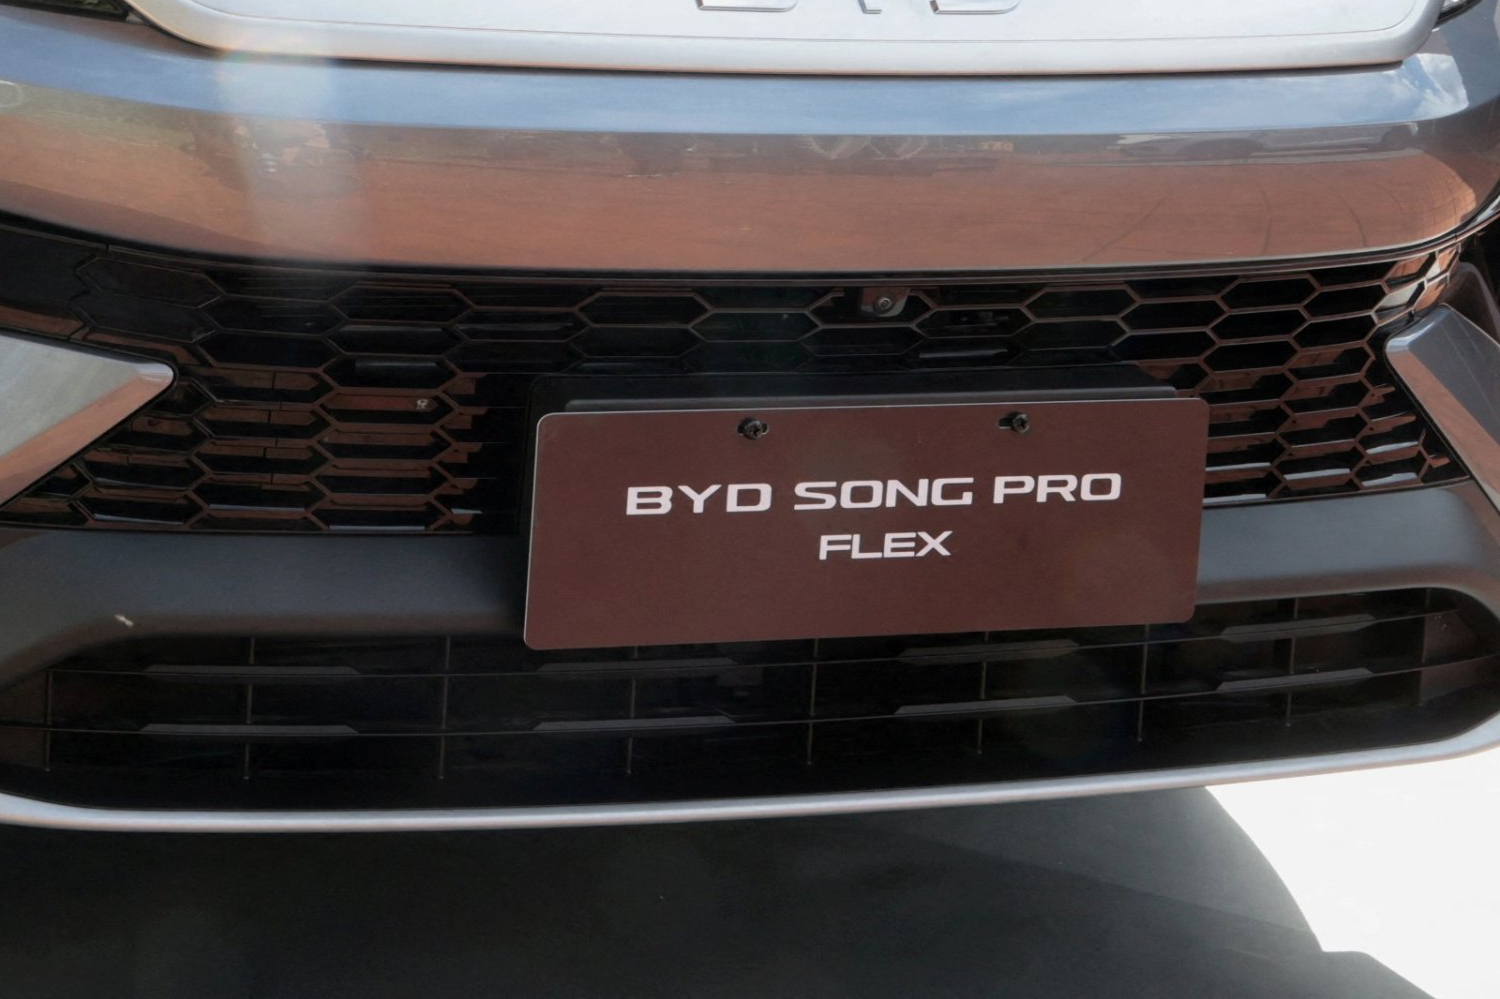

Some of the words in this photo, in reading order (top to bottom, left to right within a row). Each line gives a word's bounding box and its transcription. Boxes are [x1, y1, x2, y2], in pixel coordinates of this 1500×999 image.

[626, 483, 773, 516] BYD
[793, 478, 975, 511] SONG
[994, 472, 1122, 504] PRO
[818, 531, 953, 561] FLEX
